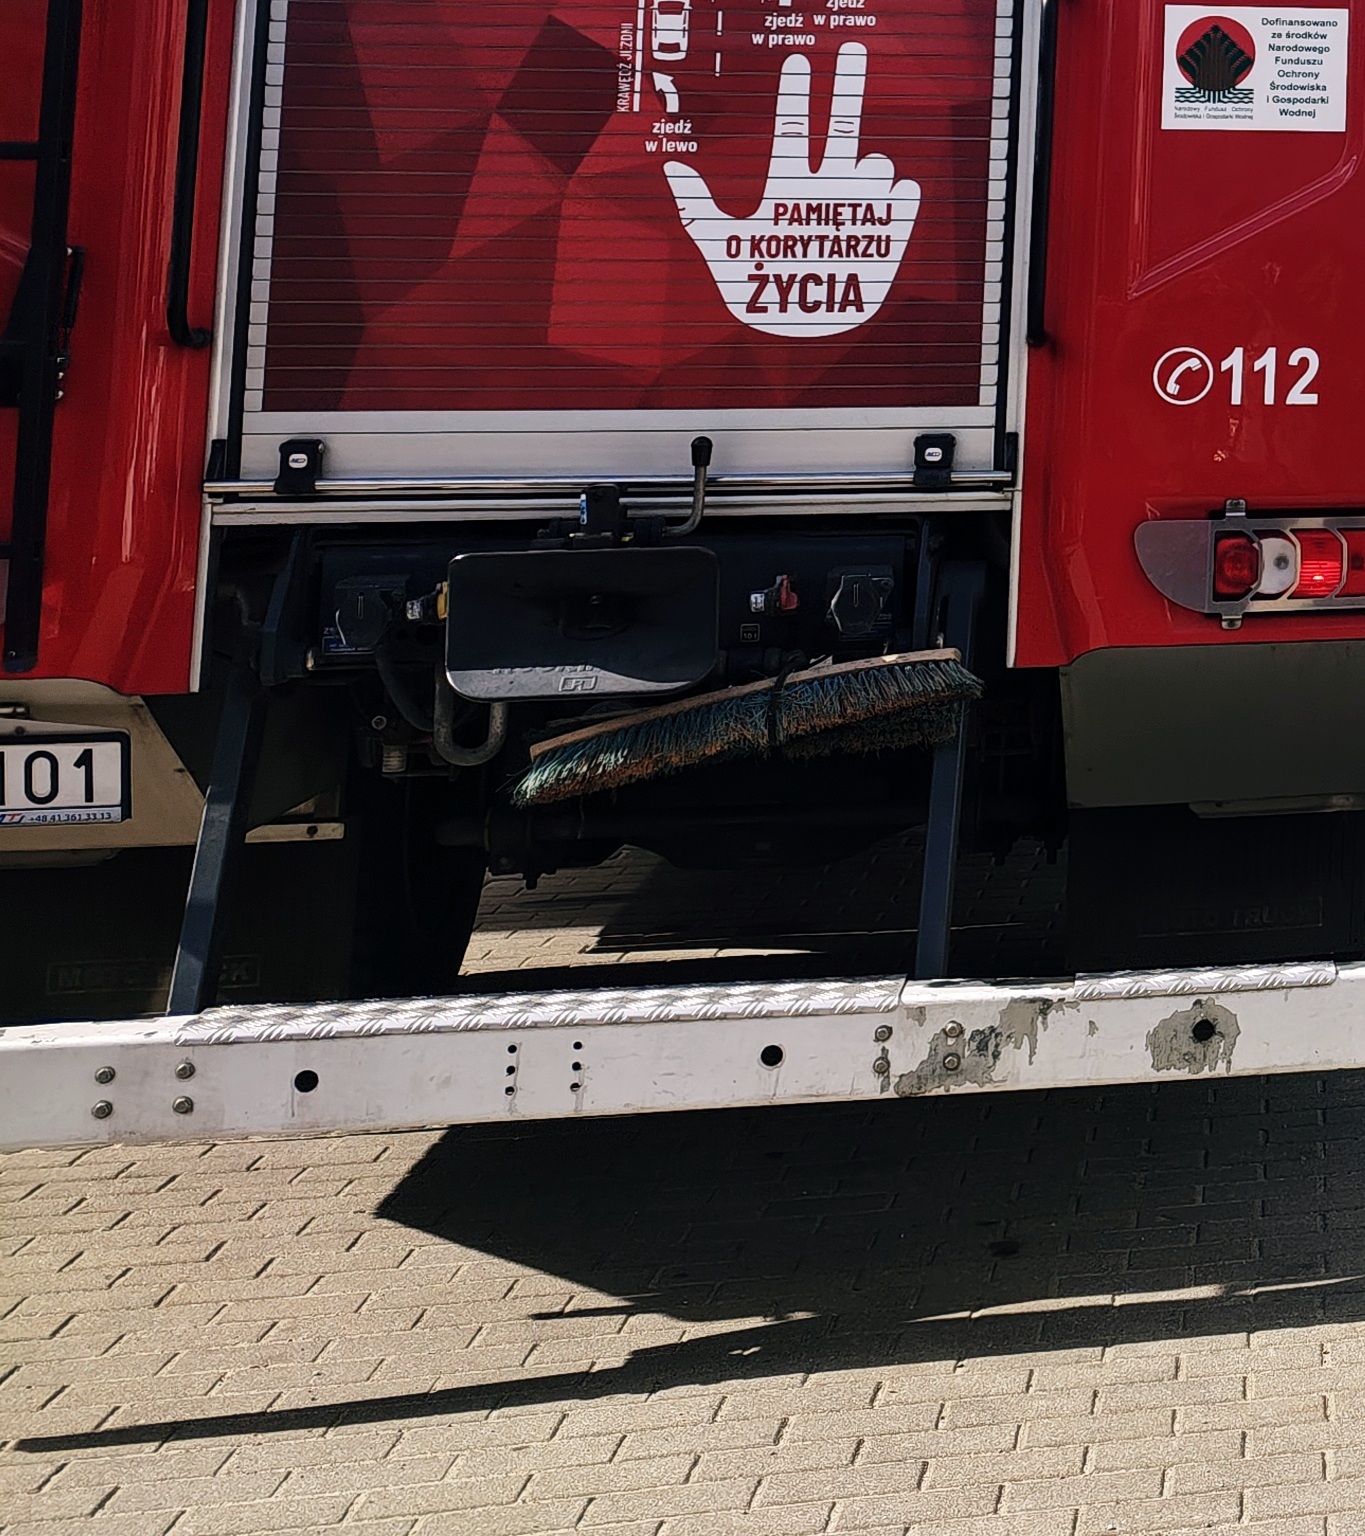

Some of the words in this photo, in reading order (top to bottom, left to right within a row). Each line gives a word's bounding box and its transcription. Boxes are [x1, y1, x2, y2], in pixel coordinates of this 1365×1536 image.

[764, 12, 804, 28] zjedź
[813, 14, 826, 26] w
[829, 14, 877, 31] prawo
[1261, 17, 1338, 27] Dofinansowano
[751, 33, 765, 45] w
[767, 33, 816, 49] prawo
[1285, 30, 1328, 40] środków
[1268, 43, 1331, 54] Narodowego
[1274, 56, 1324, 66] Funduszu
[1277, 69, 1320, 80] Ochrony
[1269, 80, 1327, 91] Środowiska
[1272, 95, 1329, 106] Gospodarki
[1279, 108, 1317, 118] Wodnej
[652, 118, 692, 138] zjedź
[645, 140, 658, 152] w
[662, 137, 698, 153] lewo
[773, 202, 893, 231] PAMIĘTAJ
[726, 234, 741, 258] O
[749, 234, 891, 259] KORYTARZU
[745, 261, 865, 314] ŻYCIA
[1219, 347, 1320, 406] 112
[0, 748, 94, 806] 01
[50, 814, 61, 822] 41
[64, 813, 82, 822] 361
[84, 813, 97, 821] 33
[100, 812, 112, 820] 13
